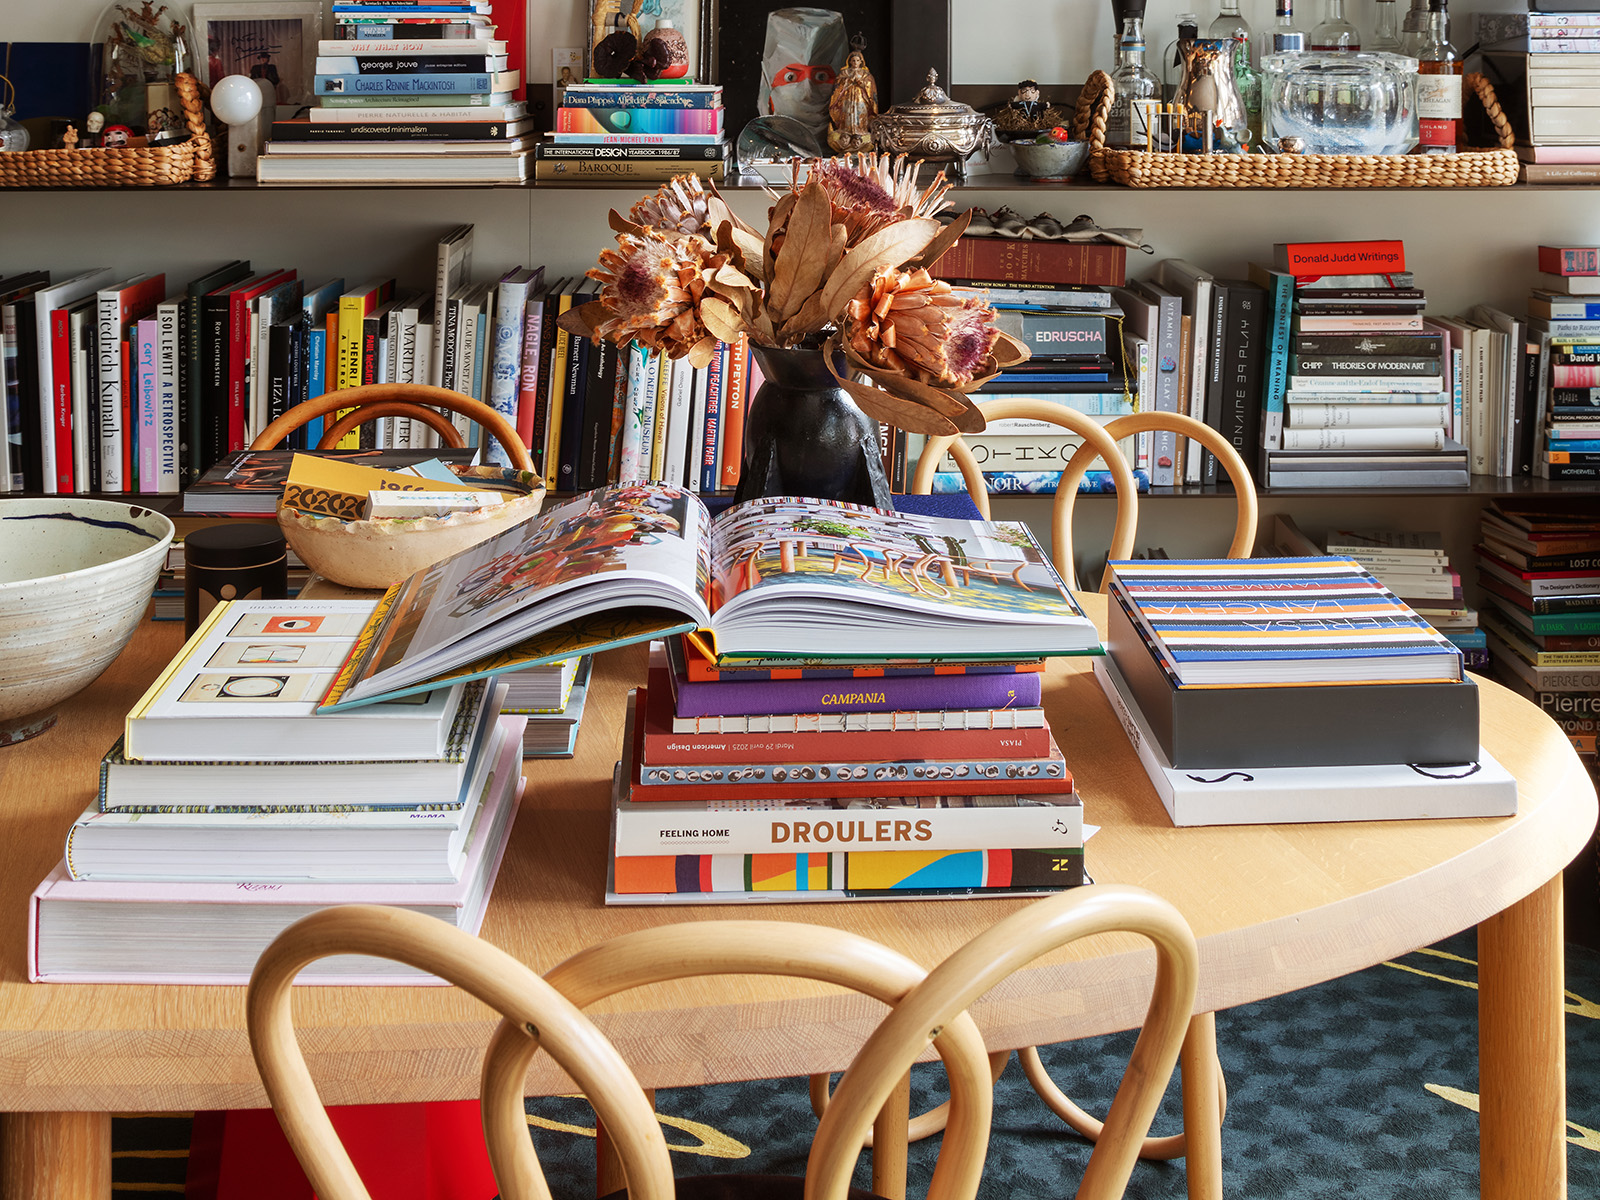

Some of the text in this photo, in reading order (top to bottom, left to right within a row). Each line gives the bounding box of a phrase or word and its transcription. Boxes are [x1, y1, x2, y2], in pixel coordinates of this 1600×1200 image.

[360, 60, 419, 71] georges jouve
[355, 79, 455, 91] CHARLES RENNIE MACKINTOSH
[350, 126, 390, 134] undiscovered
[594, 147, 628, 158] DESIGN
[578, 162, 633, 176] BAROQUE
[1293, 250, 1400, 264] Donald Judd Writings
[162, 316, 173, 338] SOL
[1165, 301, 1174, 339] VITAMIN
[162, 339, 173, 377] LEWITT
[522, 314, 540, 392] NAGLE, RON
[100, 298, 119, 439] Friedrich Kunath
[569, 335, 582, 395] Barnett Newman
[1301, 360, 1323, 370] CHIPP
[1331, 361, 1425, 370] THEORIES OF MODERN ART
[140, 342, 154, 427] Cary Leibowitz
[731, 363, 743, 409] PEYTON
[642, 366, 657, 455] O'KEEFFE MUSEUM
[703, 373, 720, 466] PEACHTREE MARTIN PARR
[162, 392, 173, 475] RETROSPECTIVE
[1148, 600, 1345, 616] LANCETA
[1242, 616, 1411, 633] TERESA
[1542, 675, 1580, 687] PIERRE
[821, 691, 886, 705] CAMPANIA
[1540, 692, 1600, 712] Pierre
[660, 827, 730, 839] FEELING HOME
[770, 818, 933, 843] DROULERS
